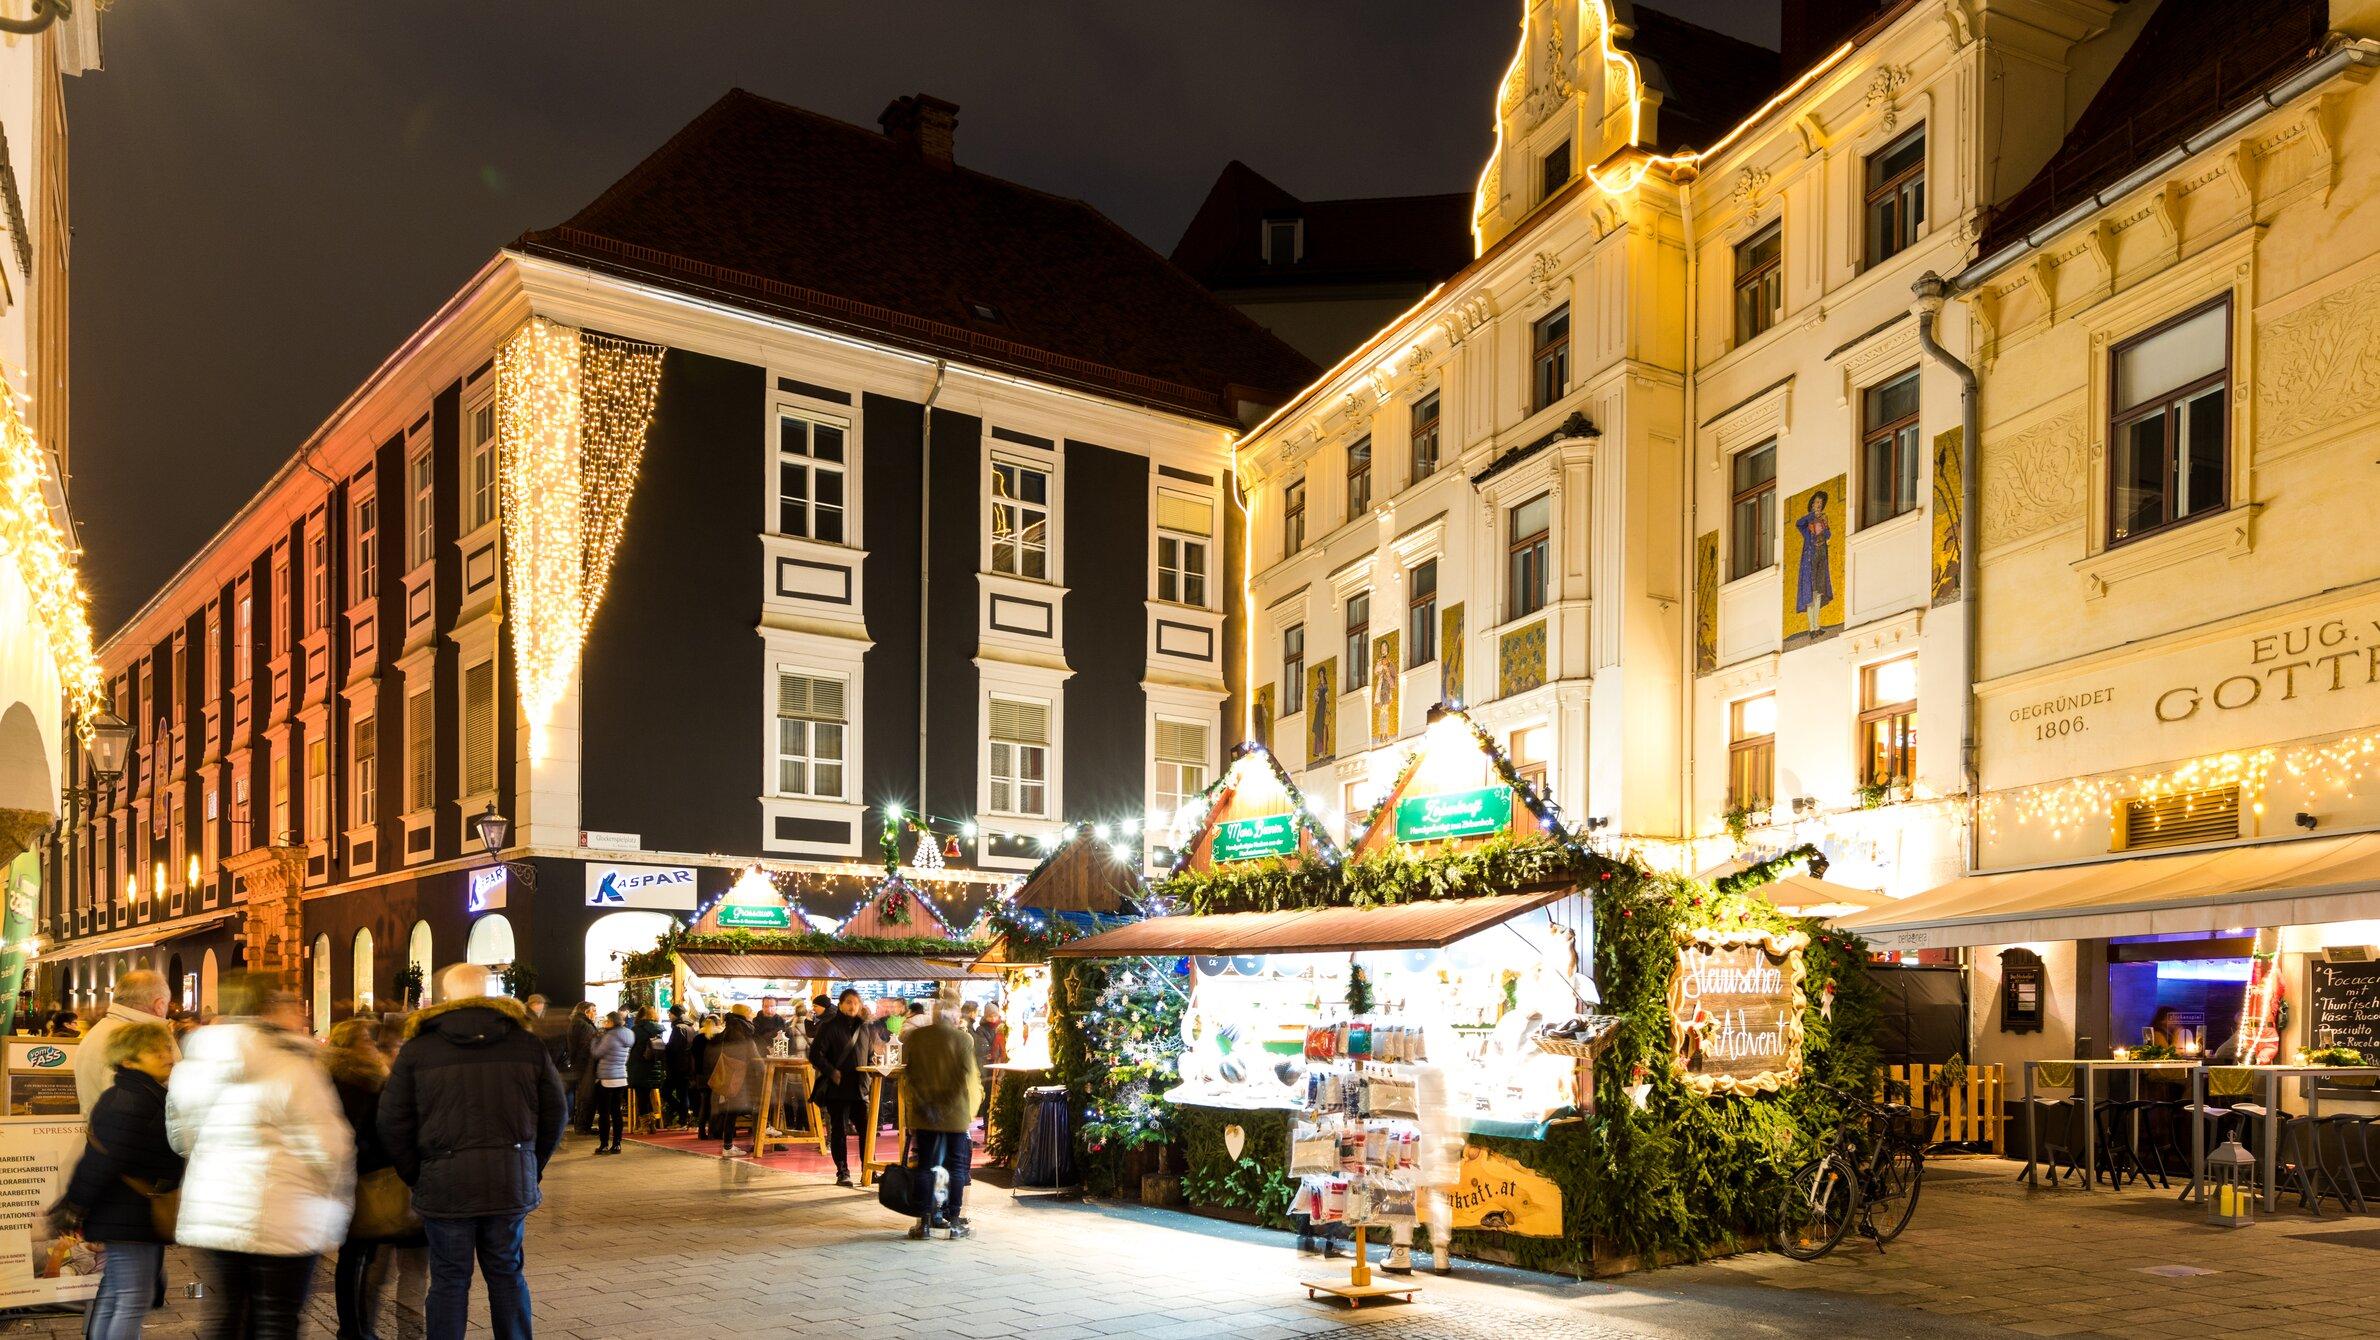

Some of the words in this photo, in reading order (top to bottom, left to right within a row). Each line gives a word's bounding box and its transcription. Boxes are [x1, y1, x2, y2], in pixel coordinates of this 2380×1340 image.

[2250, 619, 2360, 665] EUG.
[2009, 687, 2115, 722] GEGRÜNDET
[2036, 715, 2090, 741] 1806.
[469, 868, 503, 908] KPAR
[591, 870, 694, 903] KASPAR
[2345, 984, 2369, 996] mit
[2320, 996, 2380, 1010] Thunfisch
[1714, 1009, 1790, 1060] Advent
[30, 1048, 47, 1058] vom
[31, 1050, 62, 1068] FASS
[33, 1127, 72, 1135] EXPRESS
[0, 1155, 35, 1163] ARBEITEN
